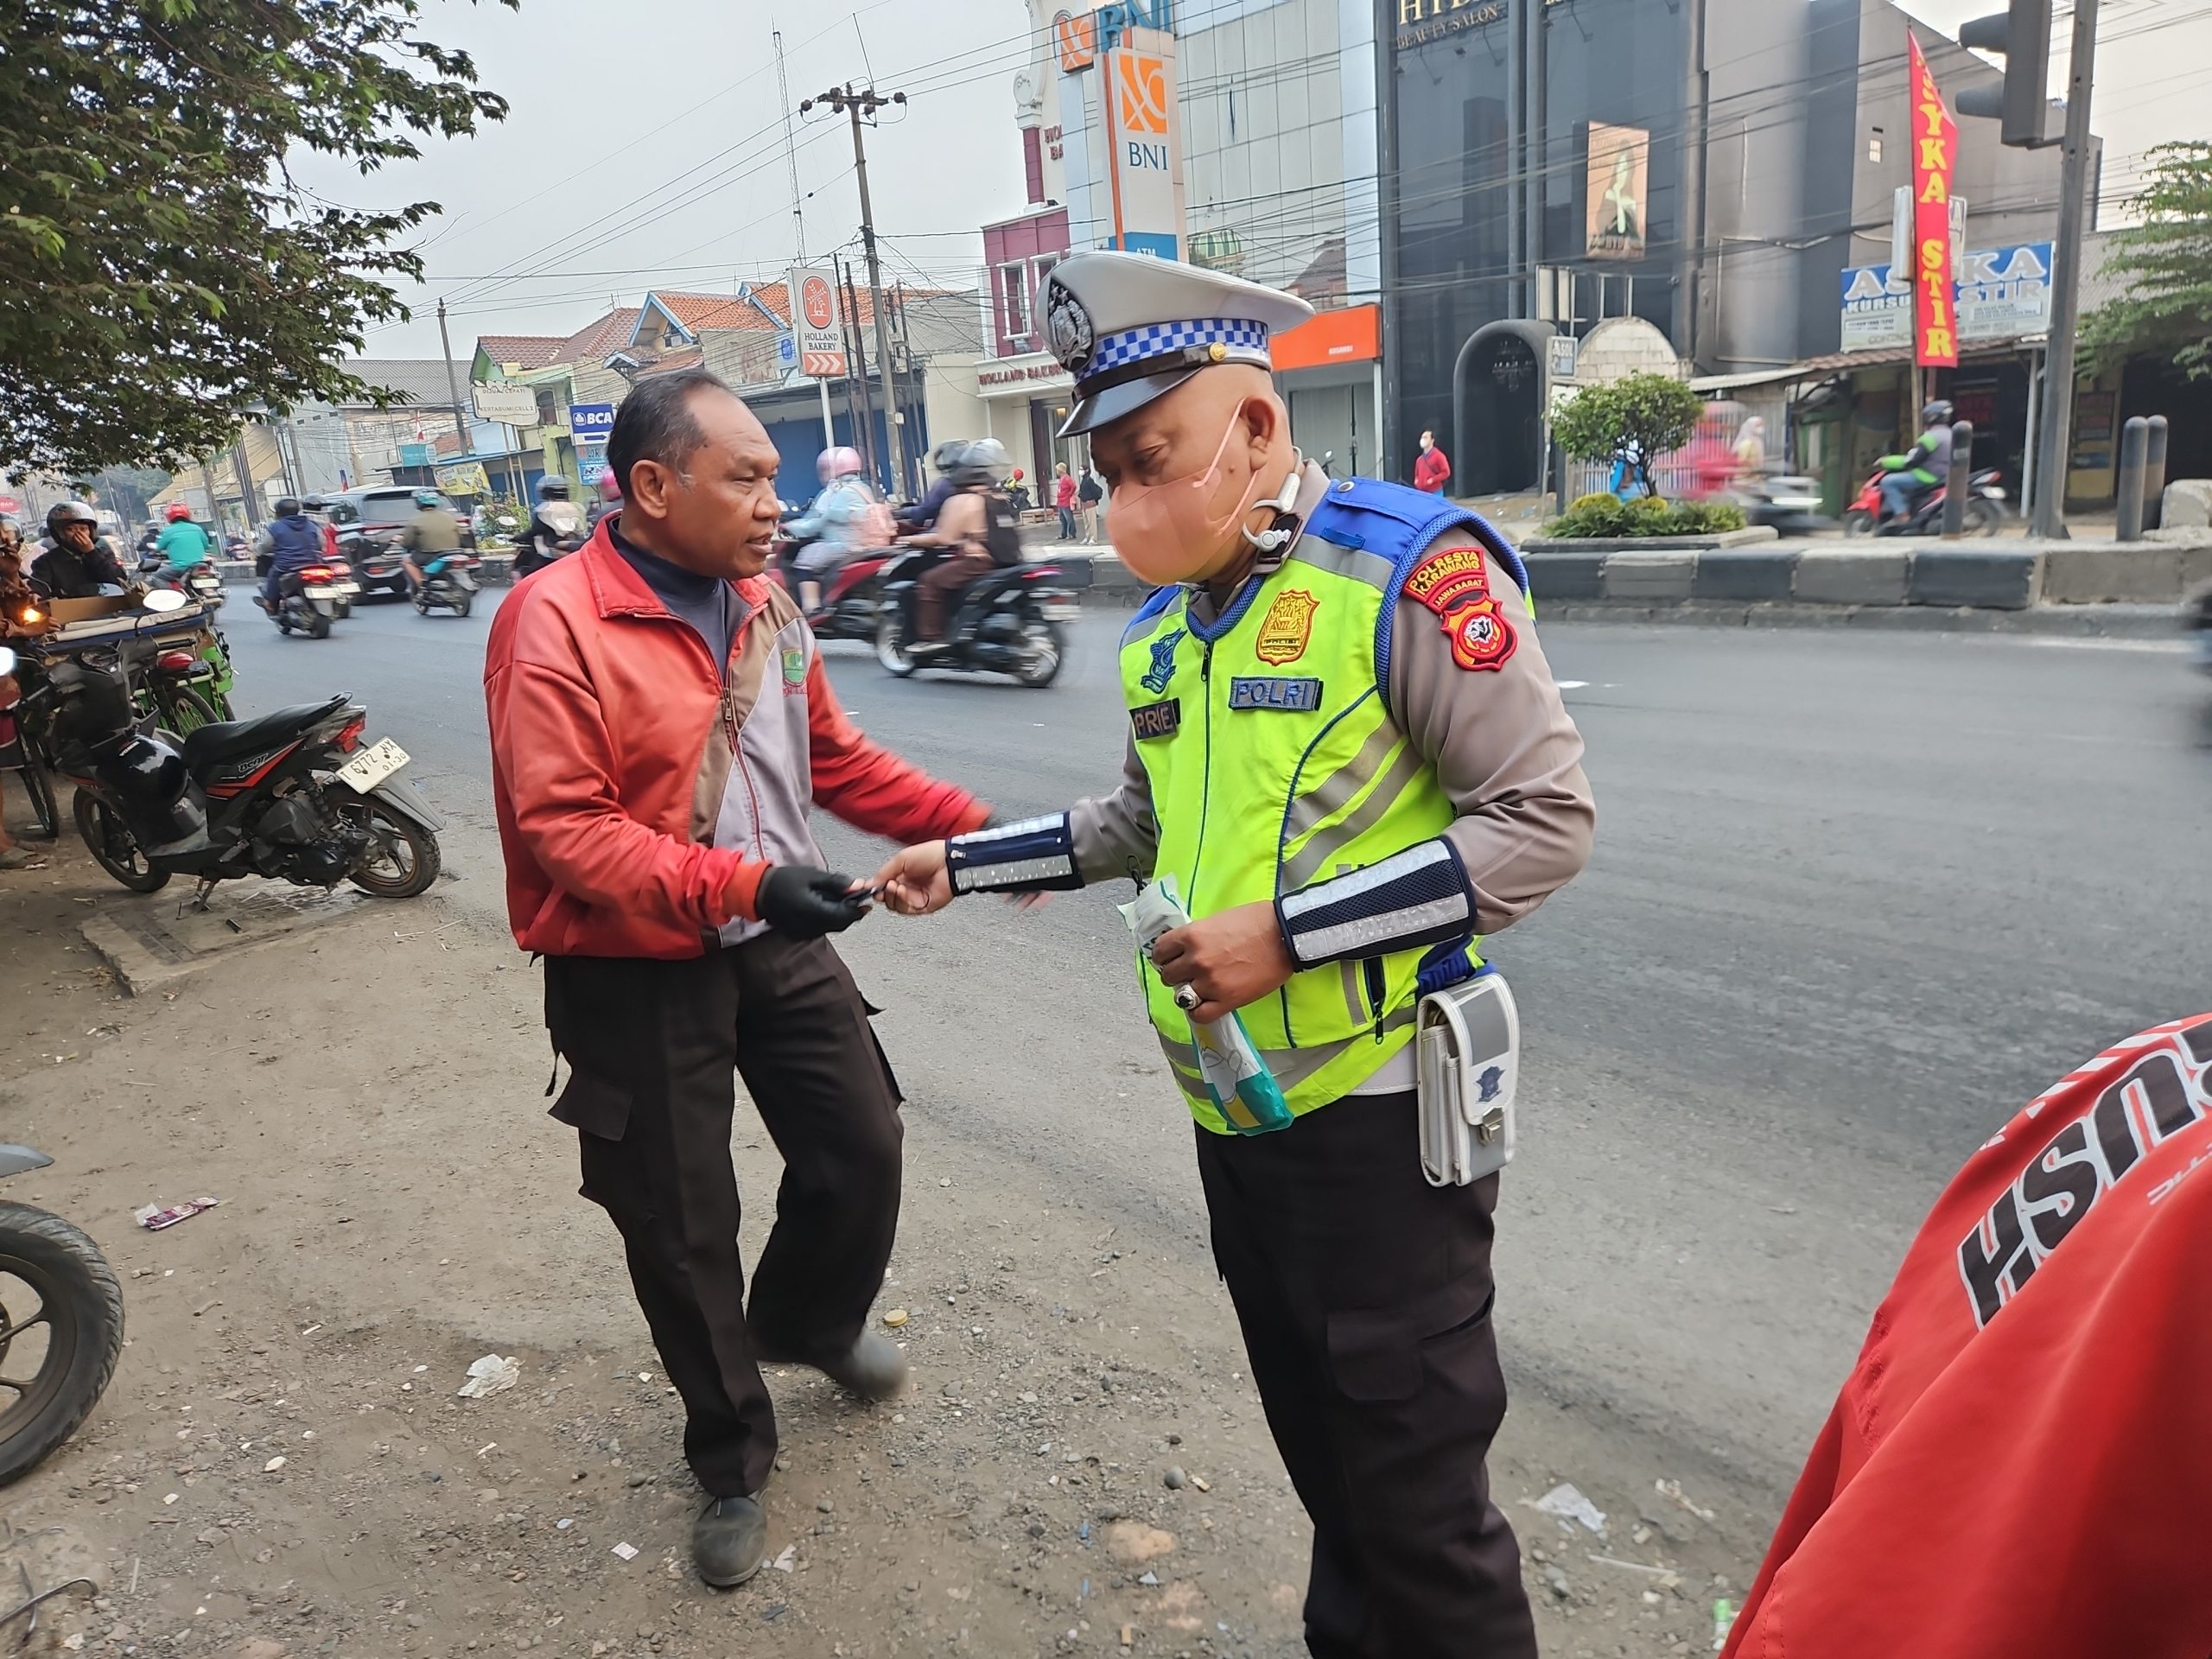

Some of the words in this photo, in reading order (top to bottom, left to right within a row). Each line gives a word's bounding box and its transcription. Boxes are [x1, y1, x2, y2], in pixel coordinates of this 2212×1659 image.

[1396, 20, 1449, 49] BEAUTY
[1452, 5, 1498, 30] SALON
[1128, 141, 1167, 170] BNI
[1135, 247, 1156, 257] ATM
[1922, 238, 1953, 358] STIR
[804, 333, 838, 341] HOLLAND
[809, 342, 836, 351] BAKERY
[979, 368, 1026, 385] HOLLAND
[587, 411, 613, 425] BCA
[1409, 551, 1480, 592] POLRESTA
[1417, 560, 1480, 595] KARAWANG
[1435, 587, 1456, 607] JAWA
[1455, 580, 1484, 592] BARAT
[1235, 681, 1311, 706] POLRI
[1134, 707, 1173, 734] PRIE
[340, 771, 352, 781] T
[350, 753, 378, 774] 6772
